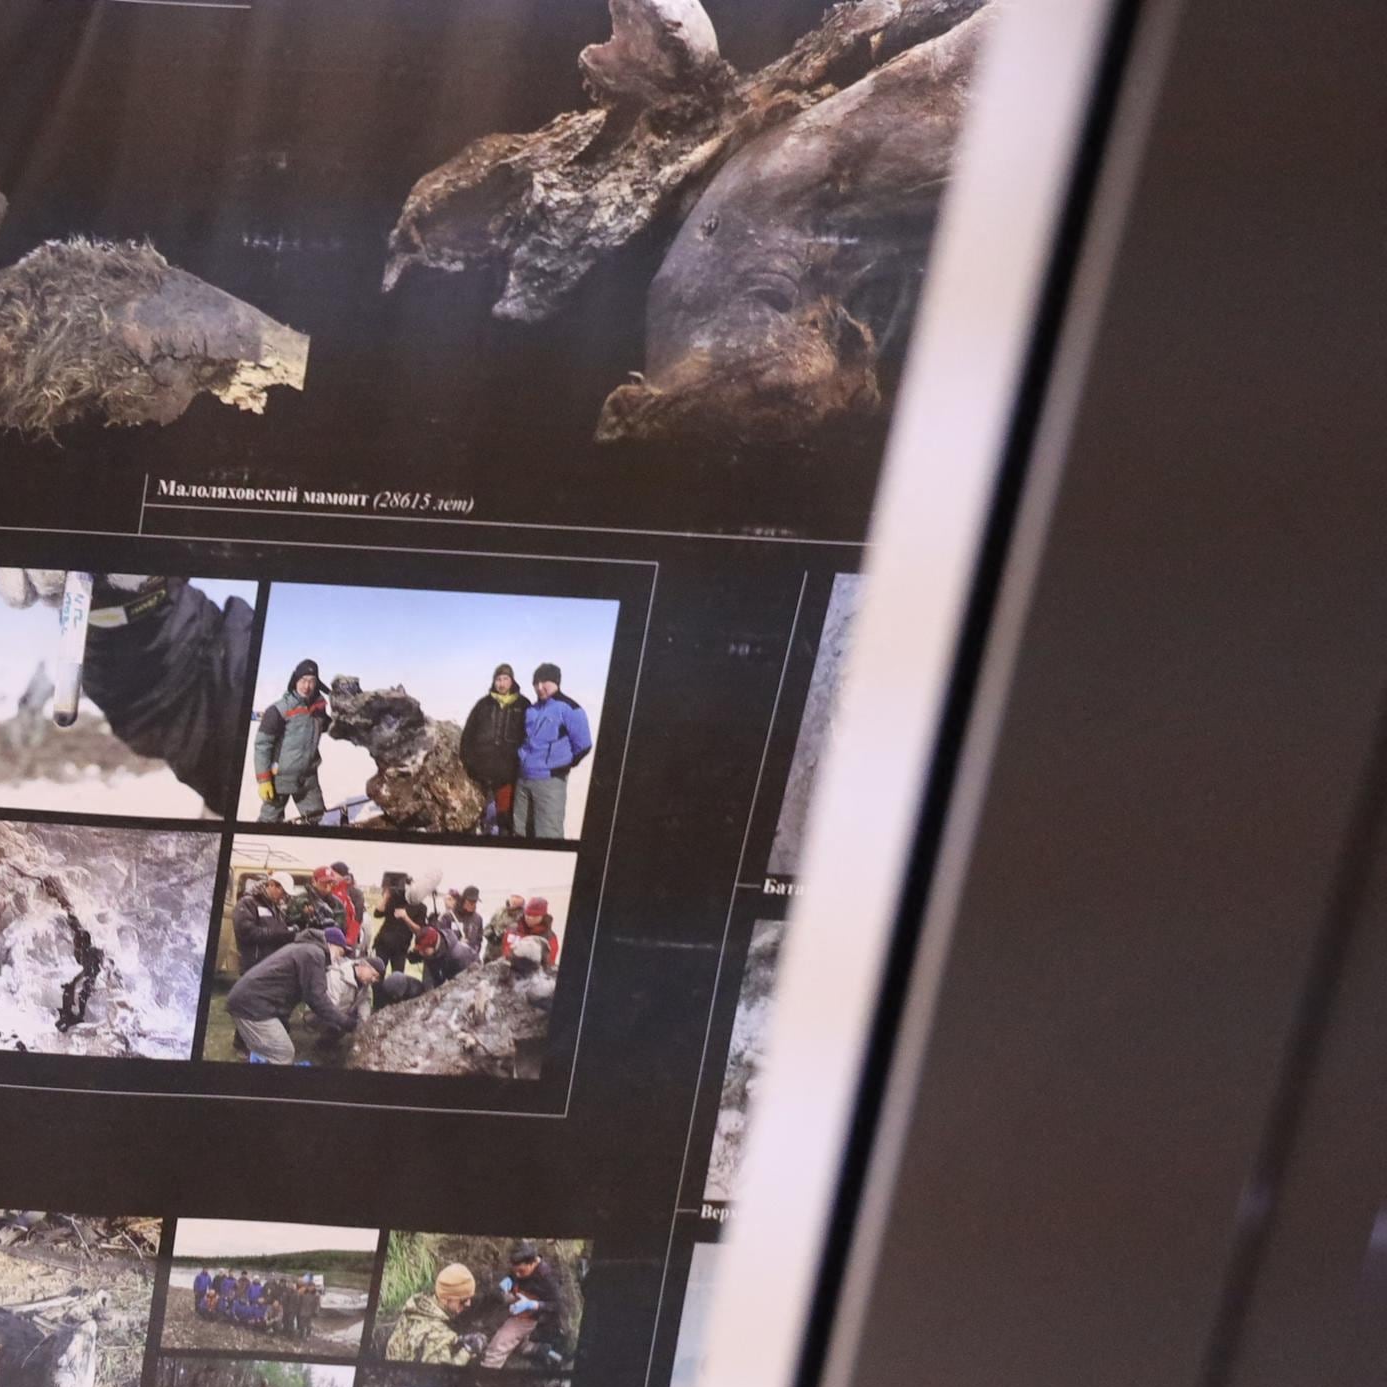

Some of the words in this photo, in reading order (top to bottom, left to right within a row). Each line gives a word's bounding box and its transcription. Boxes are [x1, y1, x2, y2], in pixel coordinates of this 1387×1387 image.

[157, 479, 298, 503] Малоляховский
[303, 491, 369, 507] мамонт
[373, 491, 431, 510] (28615
[433, 496, 474, 514] лет)
